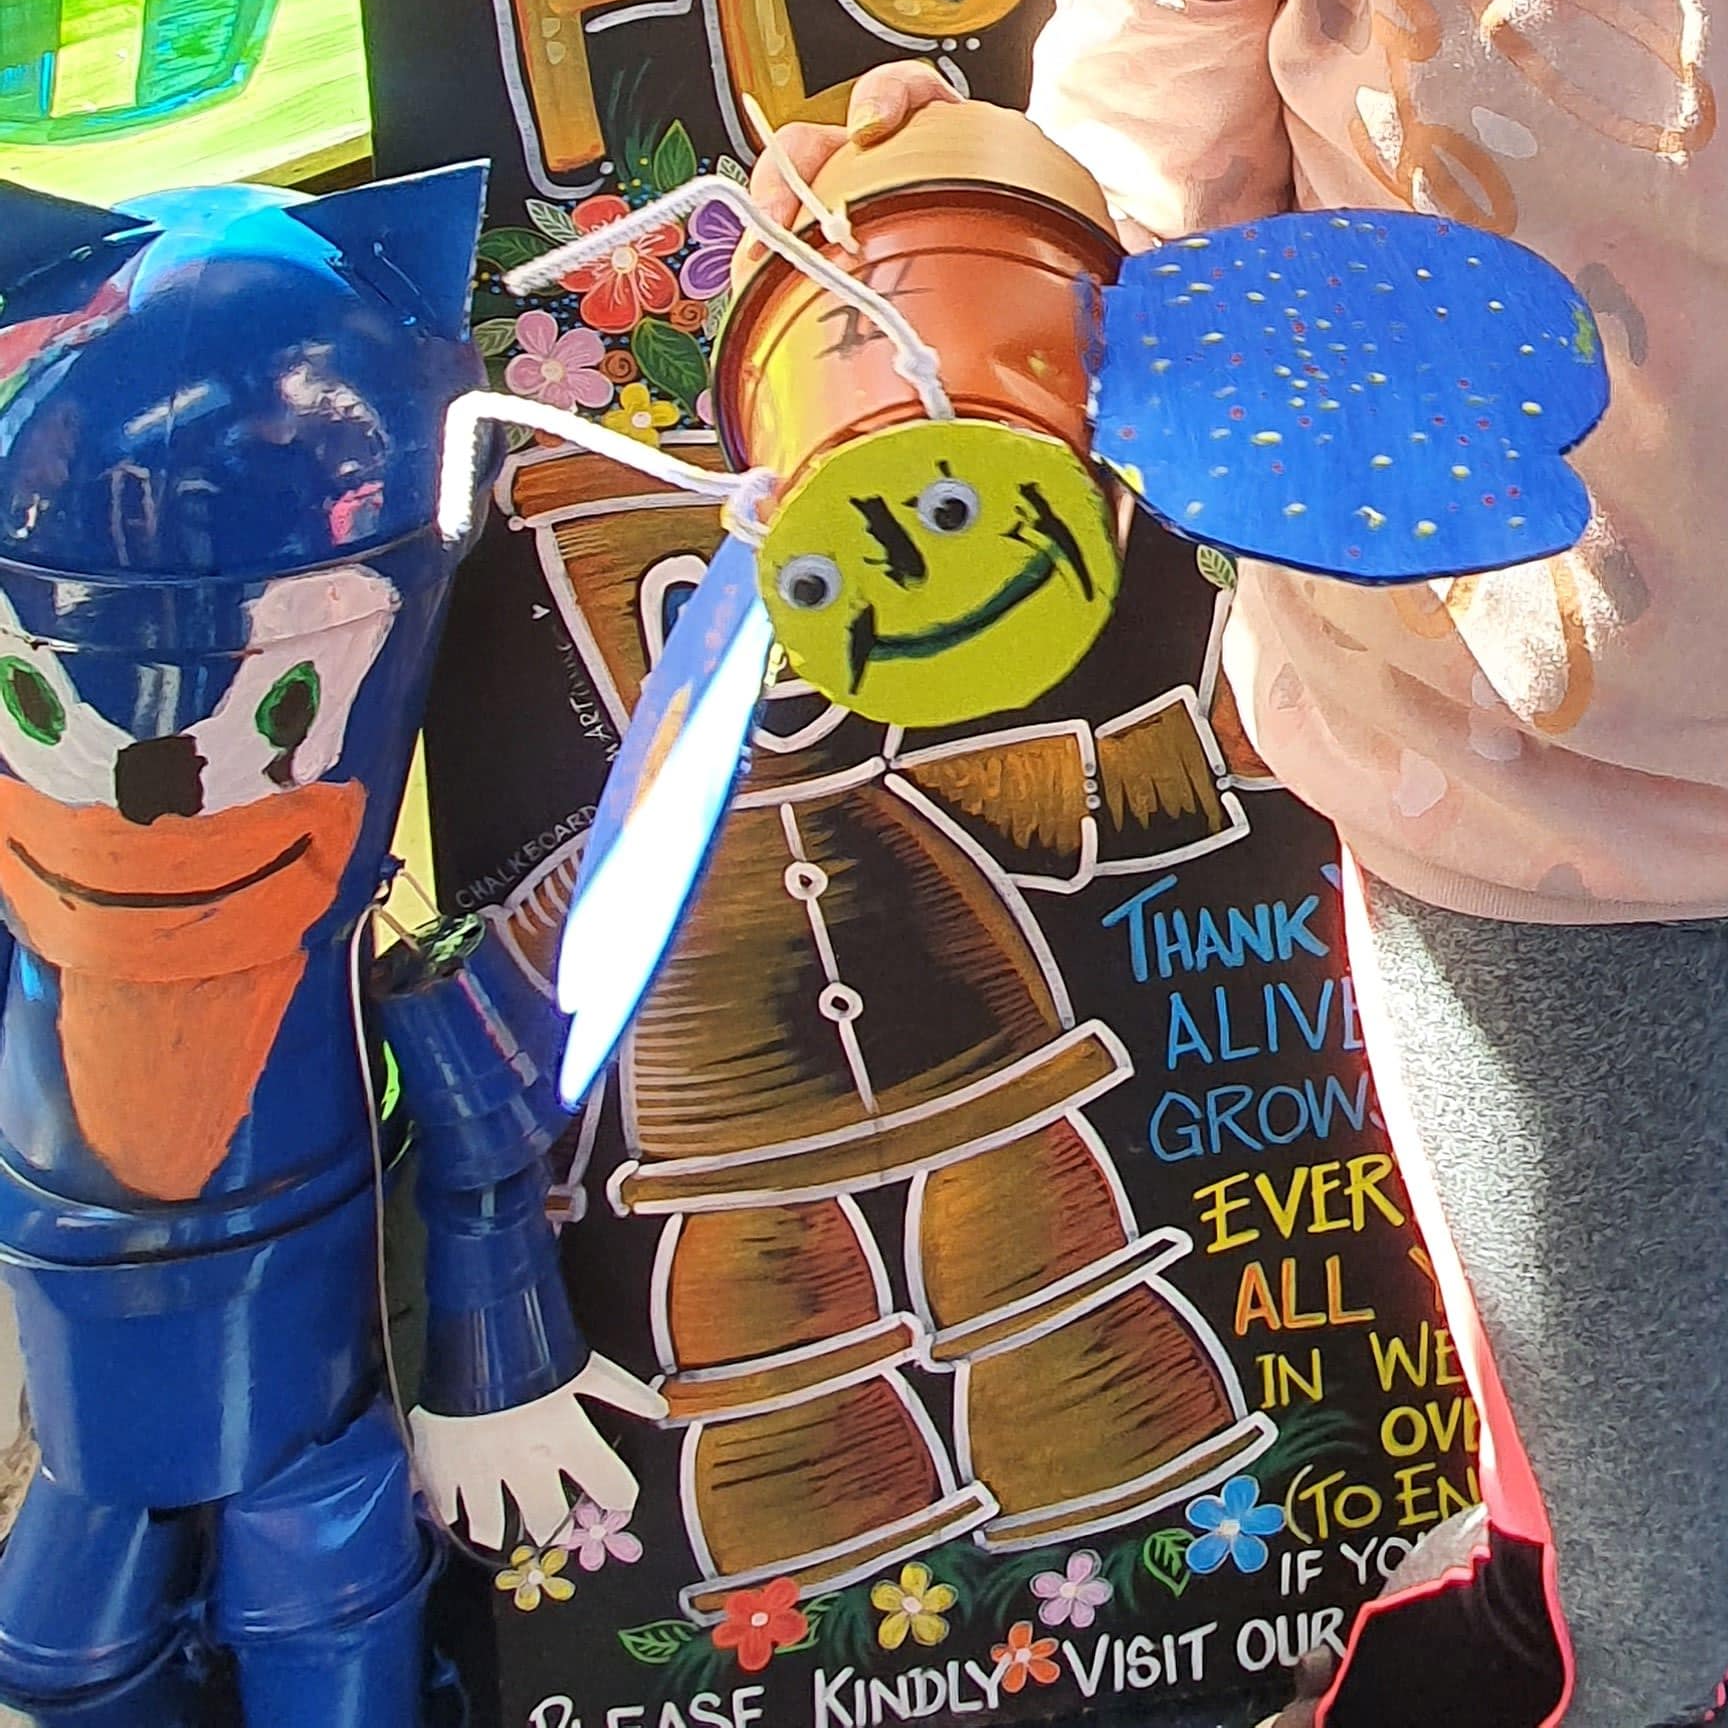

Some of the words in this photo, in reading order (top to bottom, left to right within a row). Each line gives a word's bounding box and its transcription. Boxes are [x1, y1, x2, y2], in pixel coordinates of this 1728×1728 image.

[1102, 874, 1330, 983] THANK
[1235, 1255, 1376, 1336] ALL
[1255, 1347, 1324, 1410] IN
[1285, 1464, 1382, 1545] (TO
[1280, 1549, 1323, 1597] IF
[813, 1654, 1012, 1728] KINDLY
[1062, 1621, 1218, 1698] VISIT
[1236, 1606, 1346, 1672] OUR
